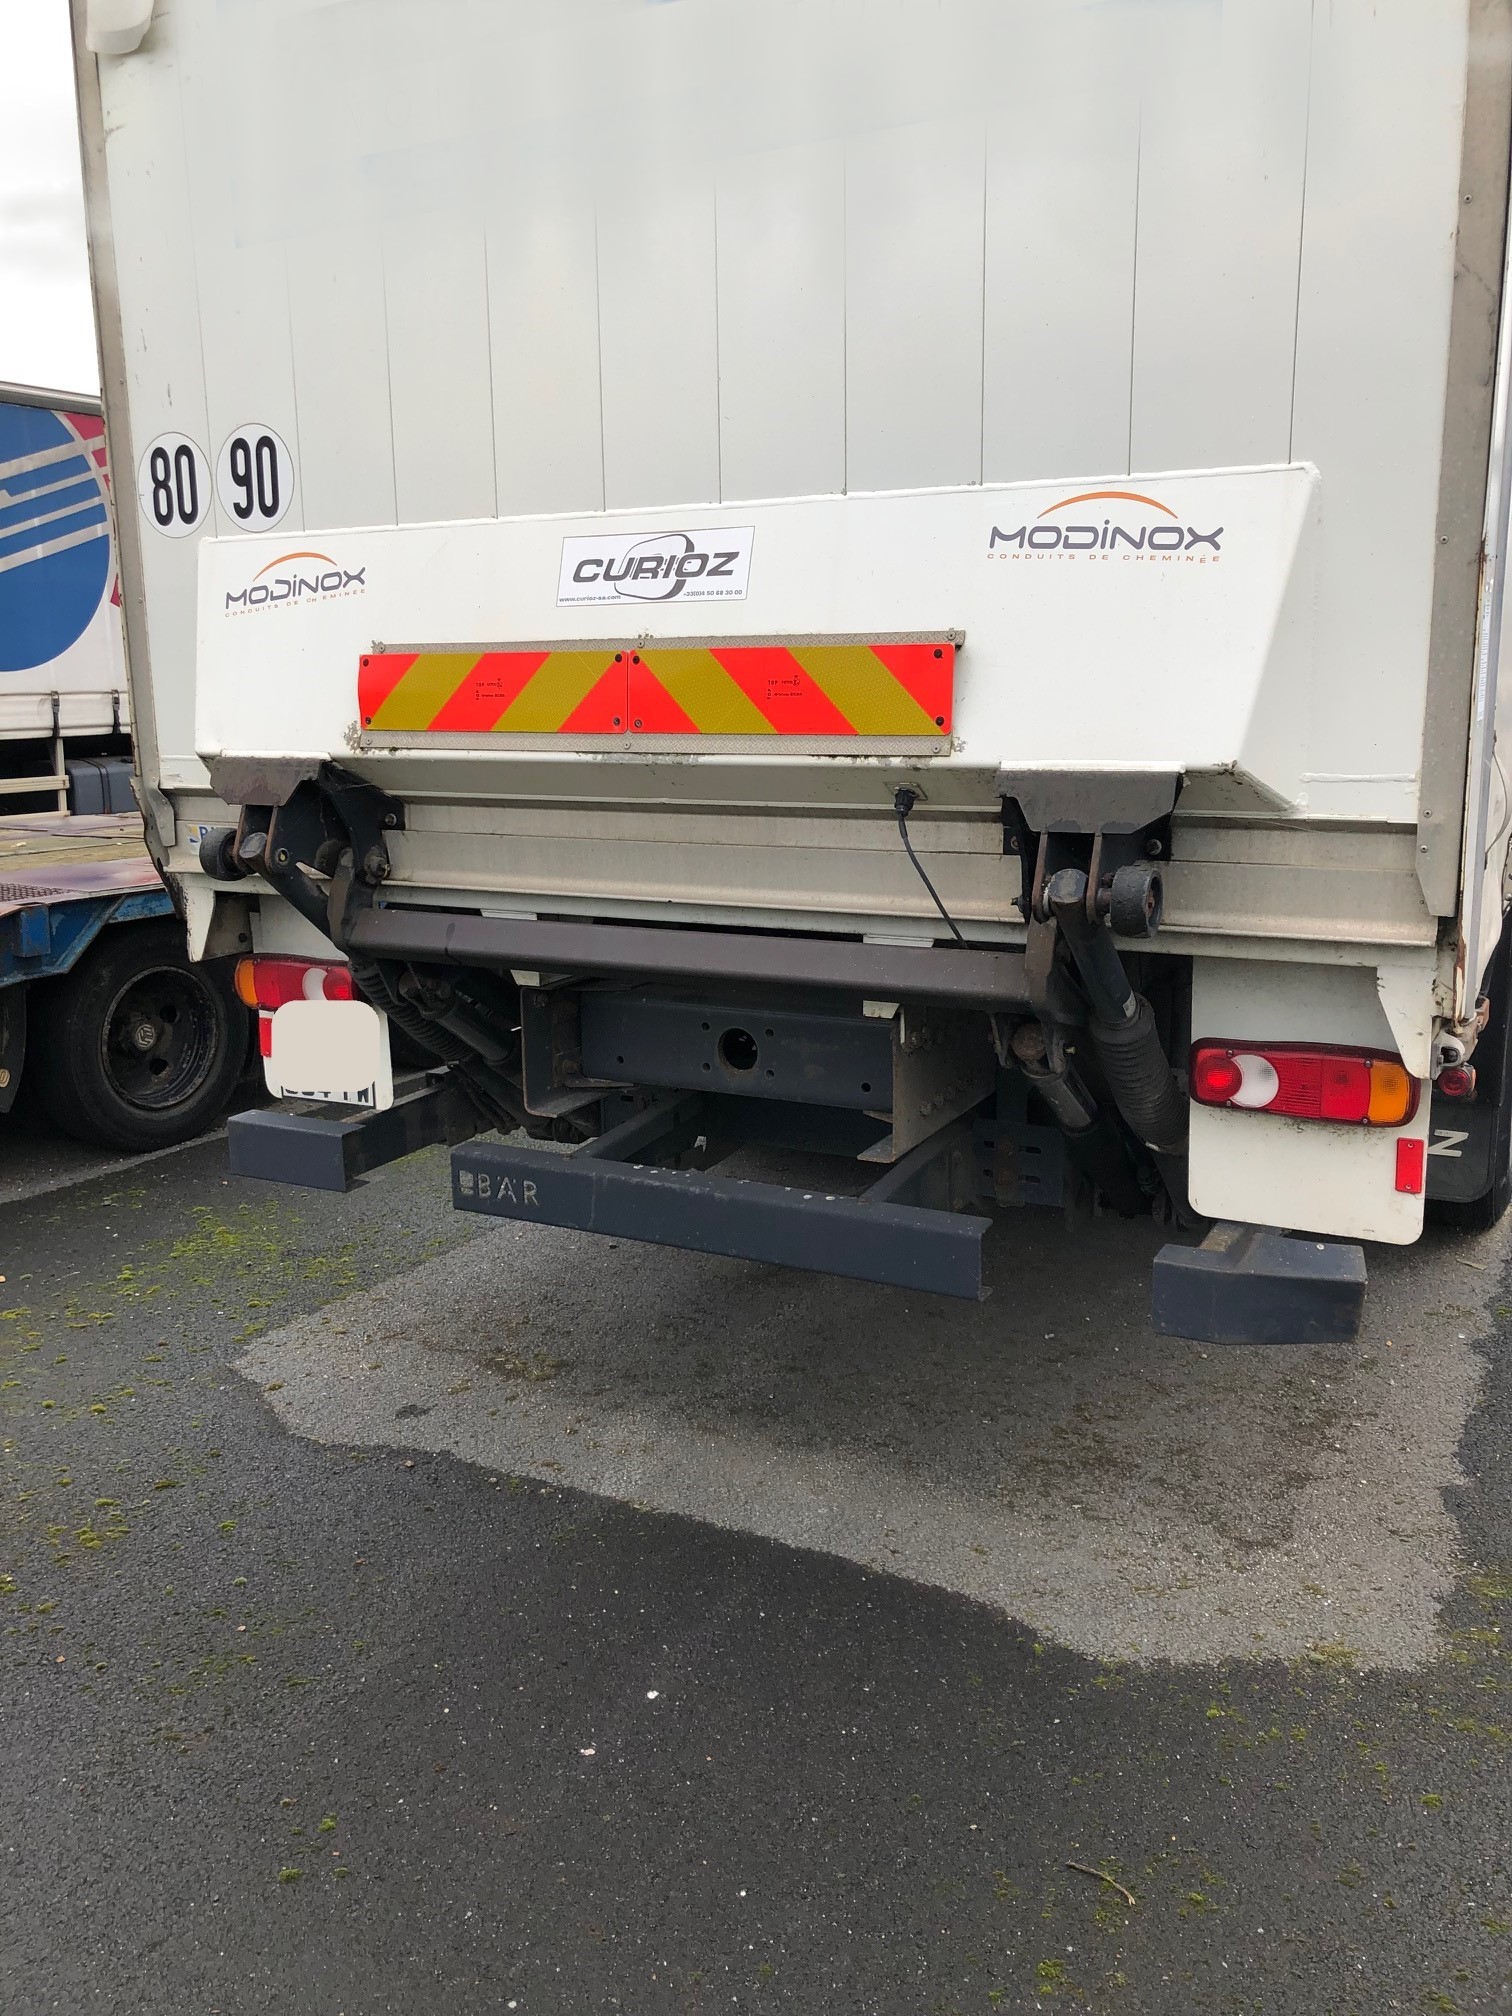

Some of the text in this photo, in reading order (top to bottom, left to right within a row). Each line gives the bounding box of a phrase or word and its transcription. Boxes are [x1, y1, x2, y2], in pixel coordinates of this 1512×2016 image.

[150, 444, 199, 527] 80
[230, 435, 280, 520] 90
[572, 551, 740, 583] CURIOZ
[1122, 553, 1220, 564] CHEMINÉE
[224, 603, 279, 618] CONDUITS
[478, 1172, 540, 1207] BÄR
